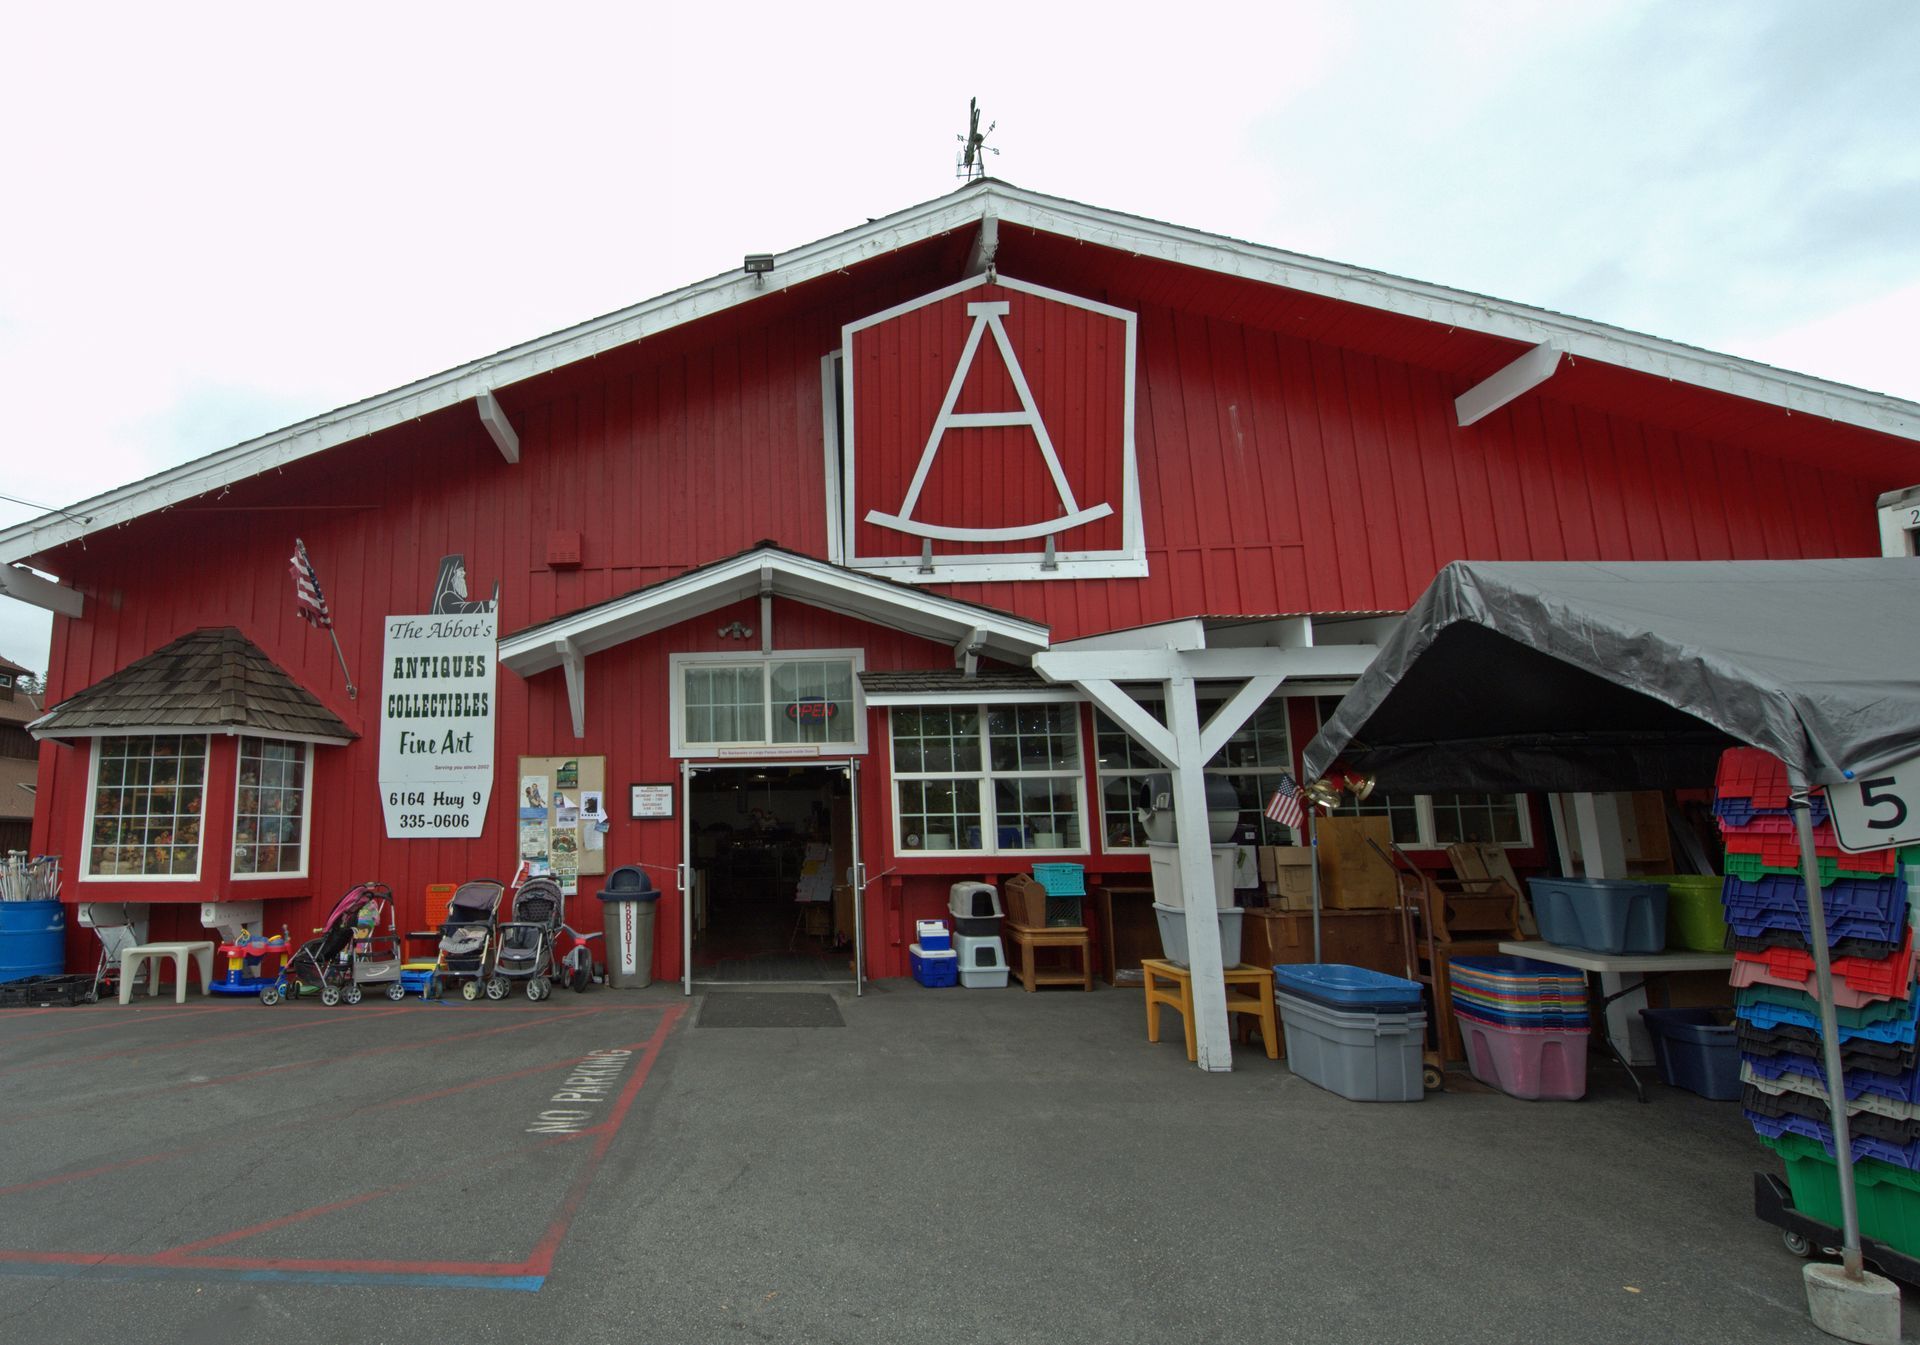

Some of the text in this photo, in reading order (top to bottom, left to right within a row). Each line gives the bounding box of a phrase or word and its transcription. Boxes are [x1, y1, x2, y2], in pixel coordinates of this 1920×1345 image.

[864, 301, 1114, 542] A
[390, 619, 492, 640] The Abbot's
[393, 655, 486, 679] ANTIQUES
[387, 692, 489, 719] COLLECTIBLES
[788, 703, 835, 718] OPEN
[400, 729, 474, 755] Fine Art
[389, 791, 481, 809] 6164 Hwy 9
[1859, 776, 1908, 830] 5
[400, 814, 470, 828] 335-0606
[525, 1049, 632, 1133] NO PARKING
